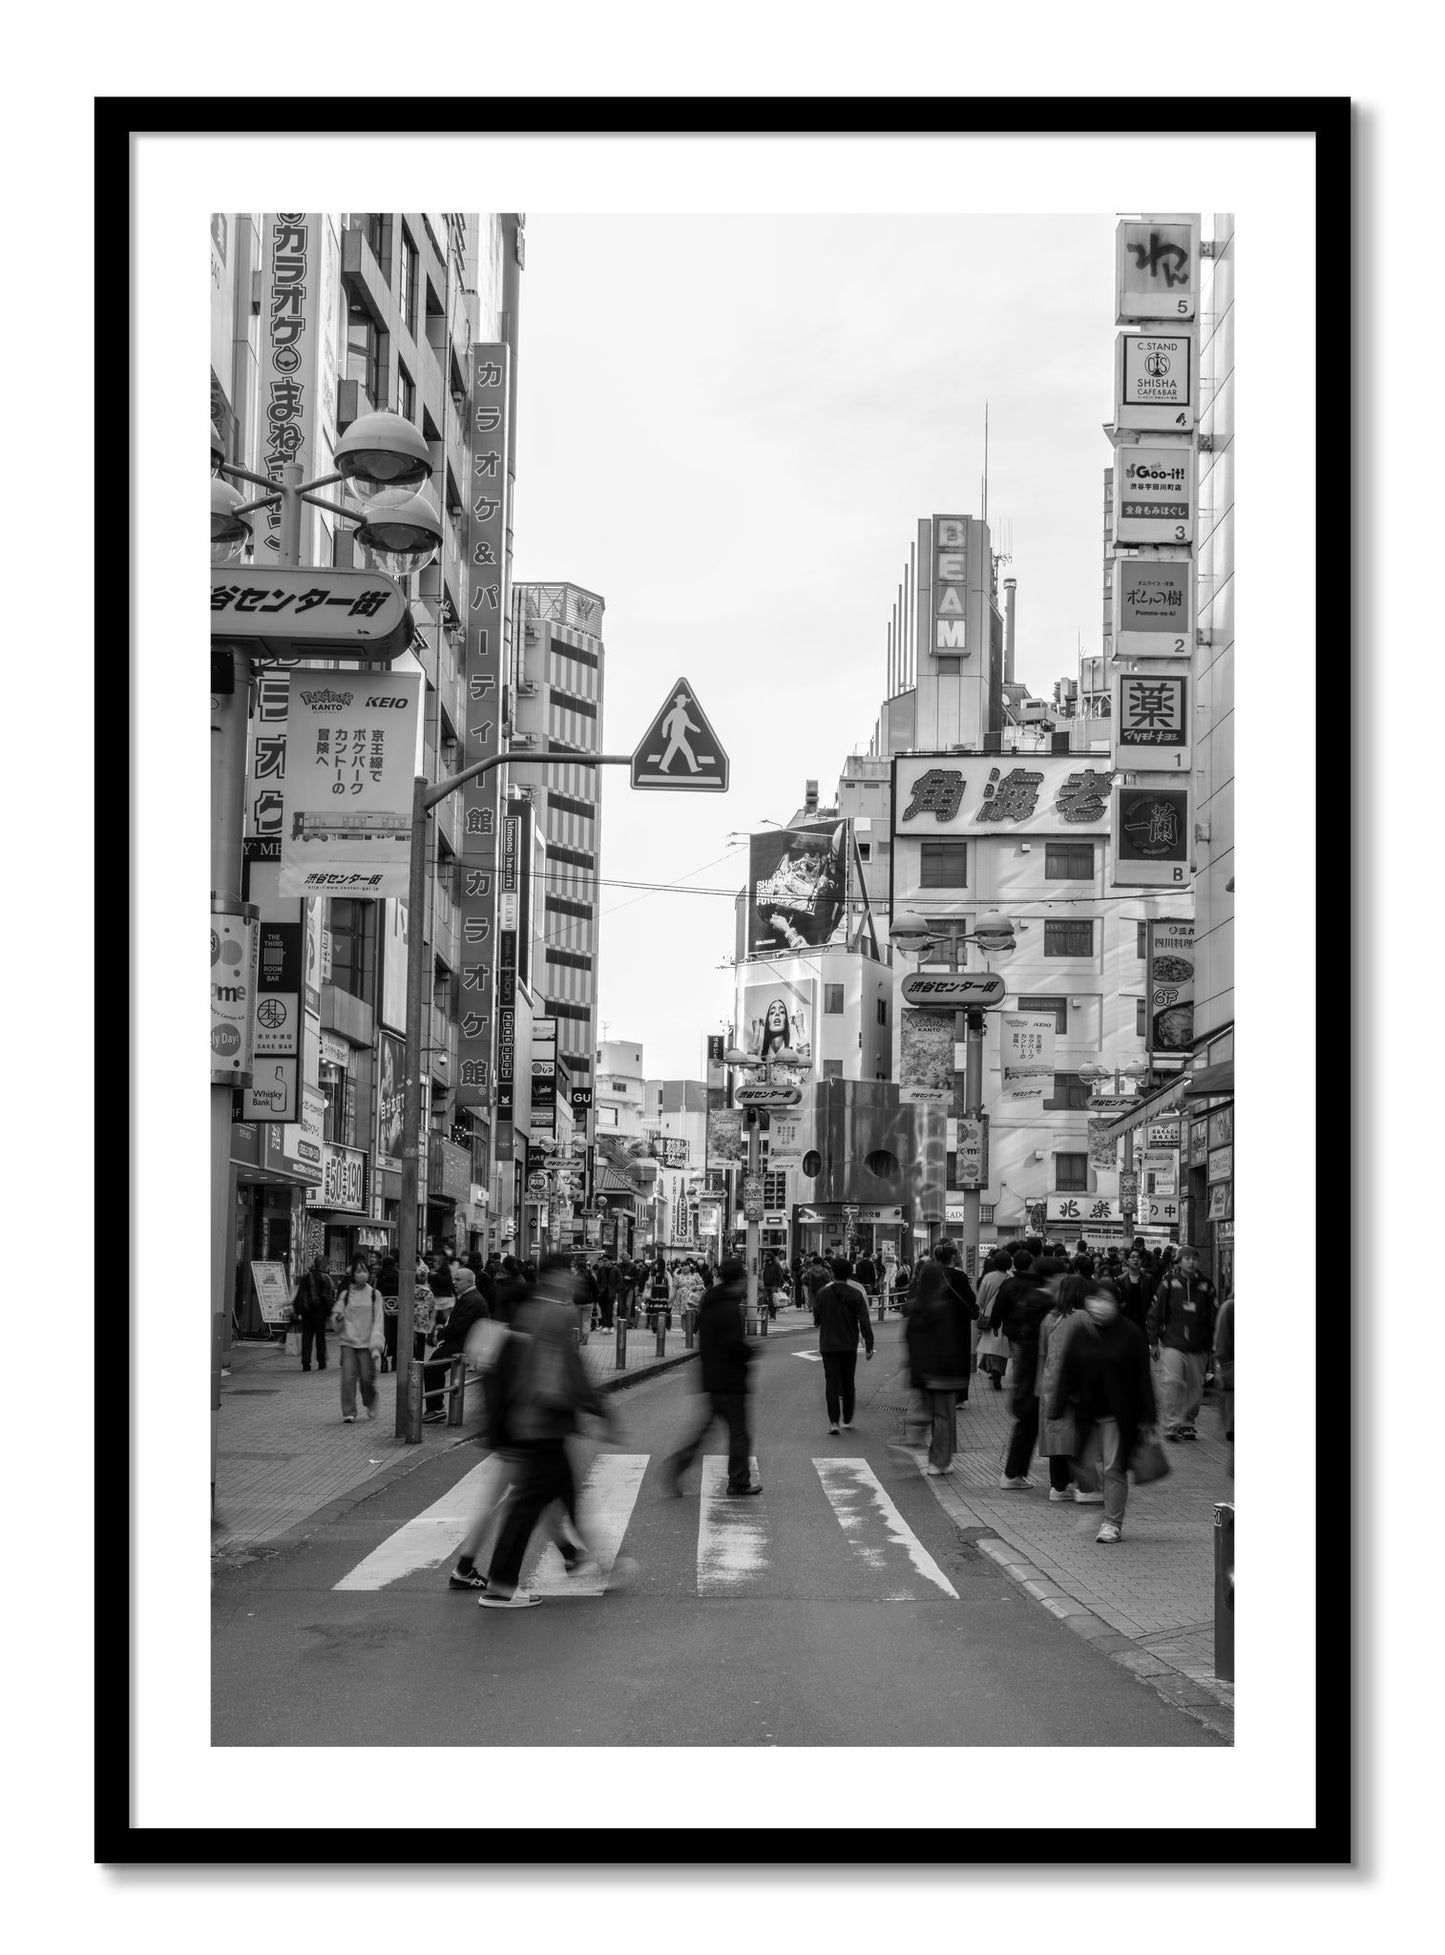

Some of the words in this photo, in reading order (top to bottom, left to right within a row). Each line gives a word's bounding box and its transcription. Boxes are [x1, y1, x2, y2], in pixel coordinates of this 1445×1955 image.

[270, 224, 308, 347] カラオケ
[1176, 300, 1188, 314] 5
[1137, 342, 1178, 351] C.STAND
[1137, 378, 1177, 388] SHISHA
[1137, 388, 1177, 396] CAFE&BAR
[1136, 465, 1185, 480] Goo-it!
[1125, 505, 1186, 516] 全身もみほぐし
[1174, 525, 1186, 540] 3
[936, 518, 967, 649] BEAM
[211, 585, 392, 618] 谷センター街
[1174, 639, 1185, 653] 2
[365, 697, 409, 709] KEIO
[1129, 682, 1175, 727] 薬
[315, 729, 331, 767] 冒険へ
[332, 729, 348, 795] カントーの
[369, 730, 385, 782] 京王線で
[1174, 753, 1181, 767] 1
[901, 768, 1115, 823] 角海老
[506, 821, 514, 853] kimono
[304, 873, 384, 885] 渋谷センター街
[506, 857, 514, 888] hearts
[1173, 867, 1183, 881] B
[908, 981, 999, 993] 渋谷センター街
[1153, 989, 1178, 1007] 6F
[221, 1032, 240, 1046] Day!
[253, 1090, 283, 1100] Whisky
[573, 1093, 591, 1103] GU
[738, 1091, 794, 1099] 渋谷センター街
[1059, 1199, 1112, 1219] 兆楽
